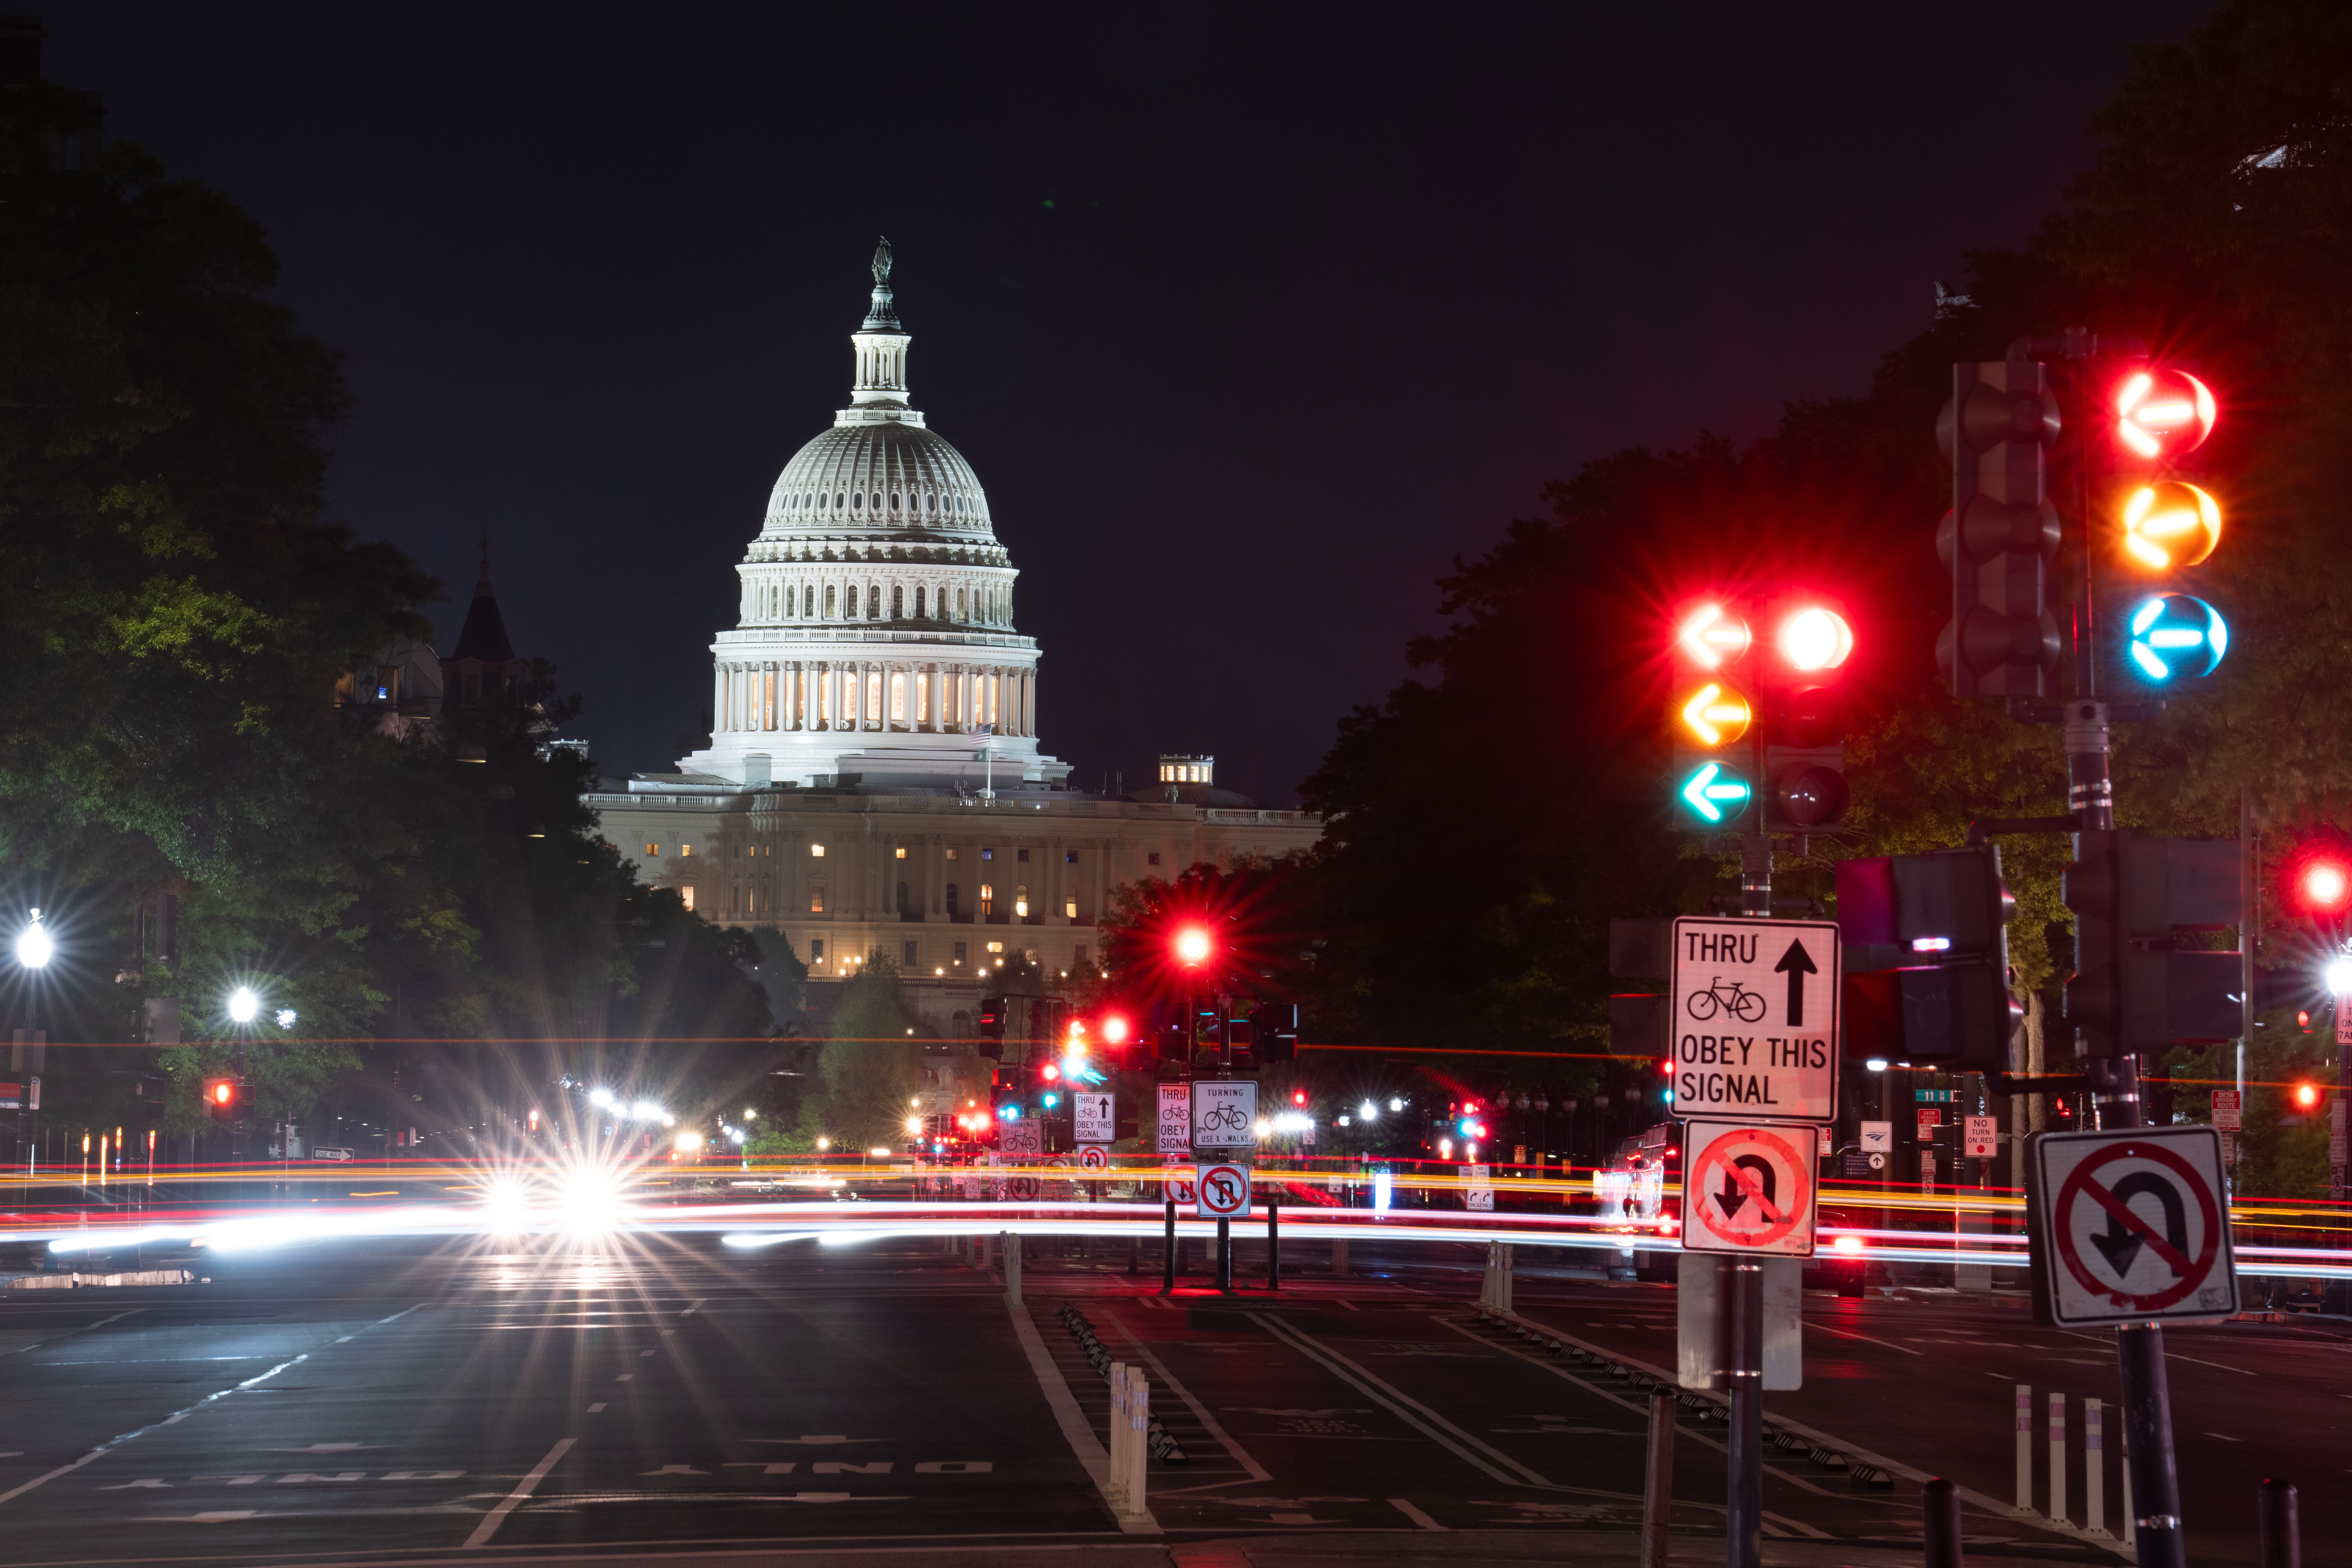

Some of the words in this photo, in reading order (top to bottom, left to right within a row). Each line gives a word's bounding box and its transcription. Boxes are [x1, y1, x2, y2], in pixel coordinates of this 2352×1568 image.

[1685, 932, 1756, 964] THRU
[1681, 1034, 1754, 1065] OBEY
[1766, 1037, 1826, 1069] THIS
[1680, 1072, 1778, 1104] SIGNAL
[1161, 1089, 1186, 1100] THRU
[1925, 1091, 1934, 1101] 11
[1161, 1125, 1186, 1135] OBEY
[1160, 1138, 1189, 1149] SIGNA
